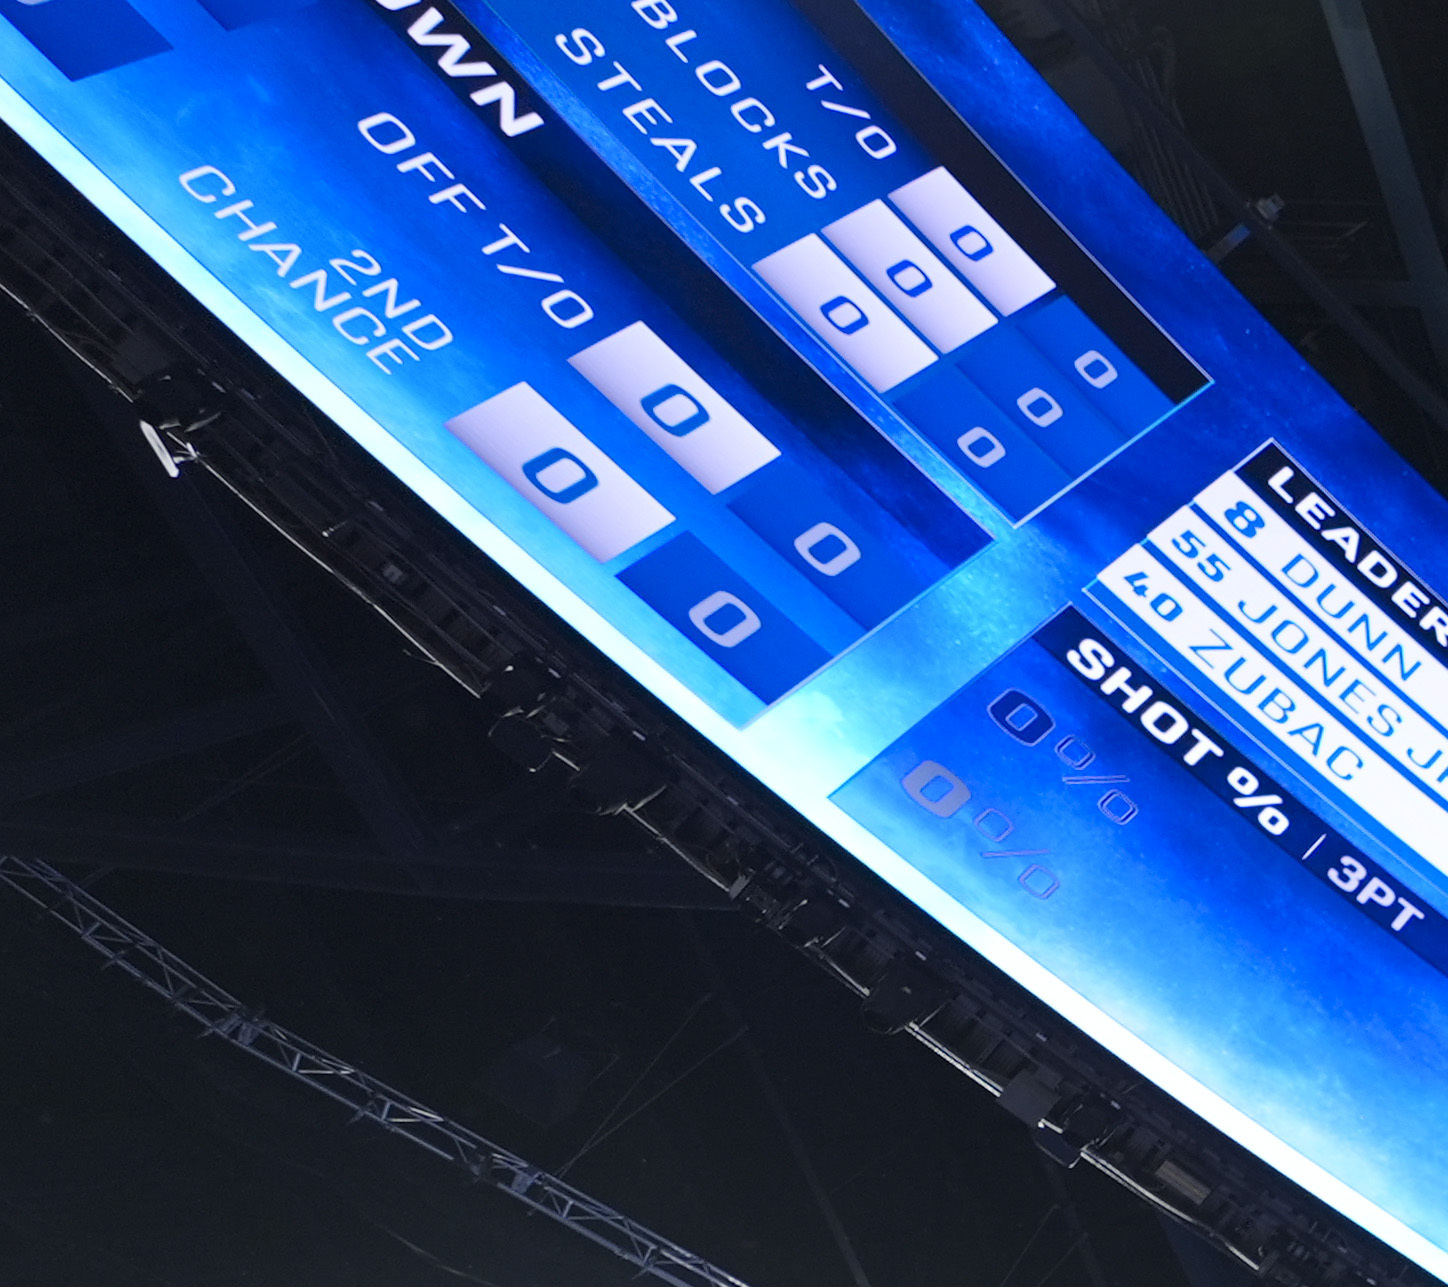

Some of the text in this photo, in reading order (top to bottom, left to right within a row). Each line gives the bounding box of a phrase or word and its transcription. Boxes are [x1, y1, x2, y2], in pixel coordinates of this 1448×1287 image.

[388, 0, 544, 137] WN
[631, 0, 838, 201] BLOCKS
[805, 64, 897, 162] T/O
[556, 27, 766, 234] STEALS
[358, 111, 595, 330] OFF T/O
[950, 225, 993, 261] 0
[179, 165, 421, 375] CHANCE
[329, 248, 453, 351] 2ND
[820, 295, 869, 335] 0
[886, 260, 933, 298] 0
[640, 383, 710, 438] 0
[1017, 388, 1062, 427] 0
[1074, 350, 1117, 387] 0
[522, 446, 598, 504] 0
[956, 426, 1005, 468] 0
[794, 521, 860, 577] 0
[1224, 500, 1266, 540] 8
[1280, 553, 1422, 682] DUNN
[688, 588, 760, 647] 0
[1170, 529, 1230, 583] 55
[1237, 597, 1403, 738] JONES
[1123, 571, 1184, 623] 40
[1189, 628, 1364, 782] ZUBAC
[1066, 637, 1425, 932] SHOT % 3PT
